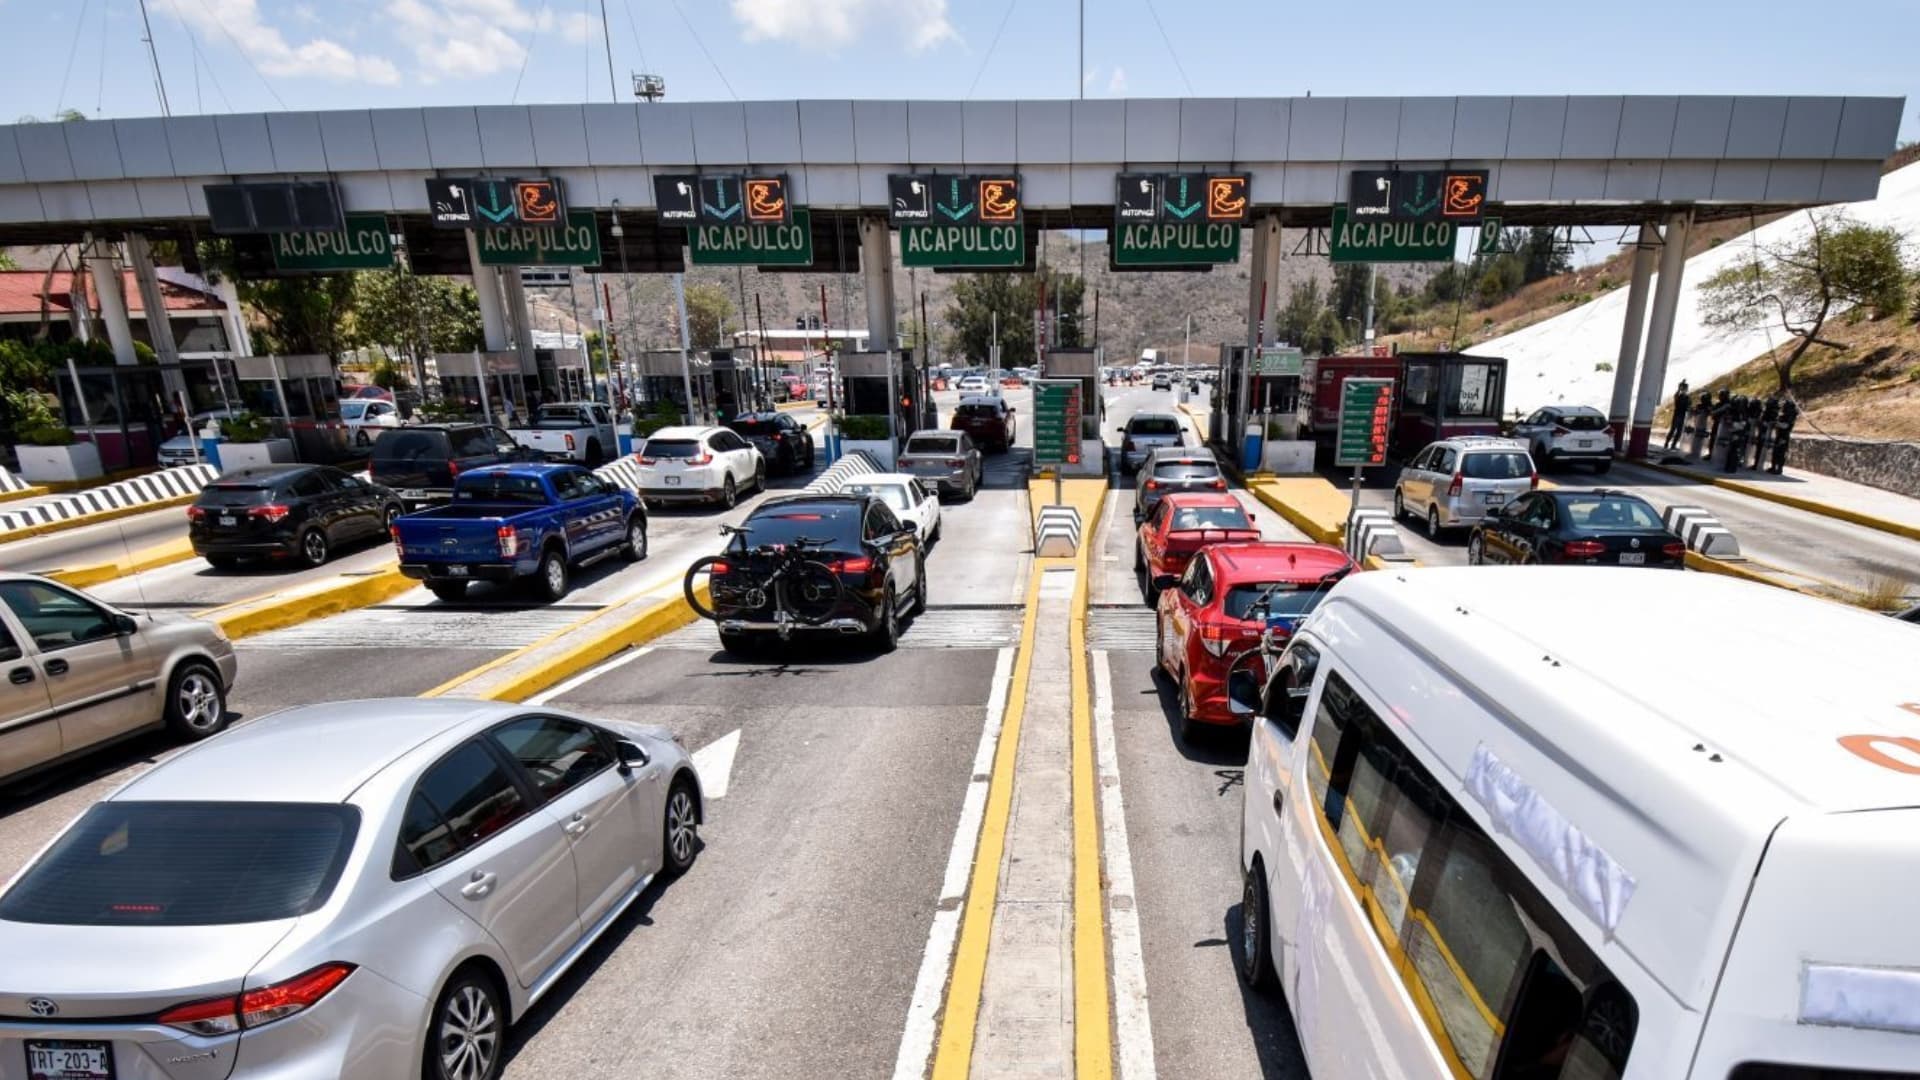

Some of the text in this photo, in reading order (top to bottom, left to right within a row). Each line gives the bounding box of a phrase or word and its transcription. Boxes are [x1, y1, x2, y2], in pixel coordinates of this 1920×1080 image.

[279, 230, 386, 256] ACAPULCO
[484, 226, 592, 251] ACAPULCO
[697, 225, 804, 250] ACAPULCO
[908, 226, 1017, 252] ACAPULCO
[1123, 224, 1233, 249] ACAPULCO
[1338, 222, 1450, 248] ACAPULCO
[1482, 220, 1498, 250] 9
[30, 1050, 109, 1070] TRT-203-A
